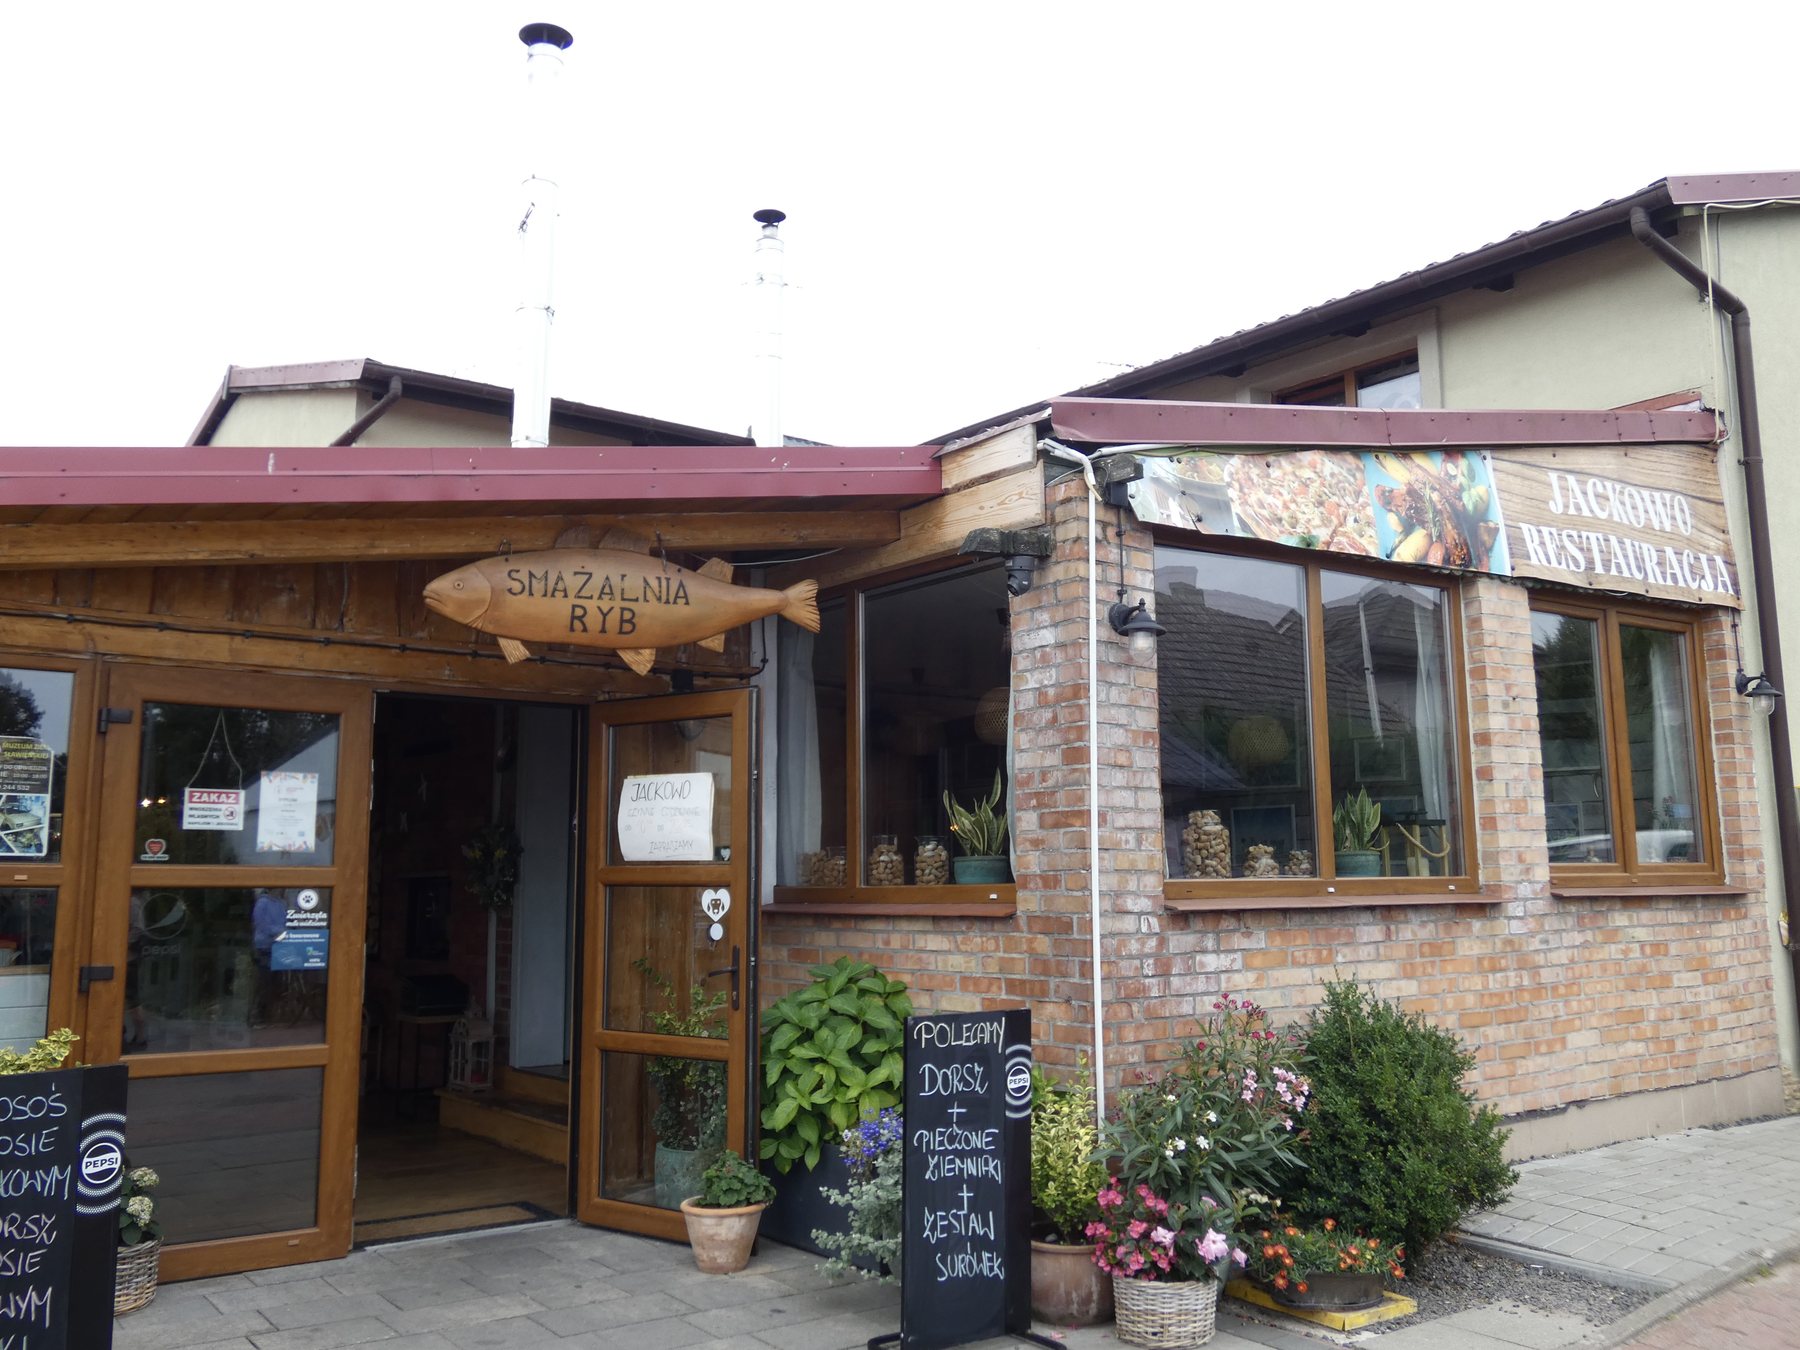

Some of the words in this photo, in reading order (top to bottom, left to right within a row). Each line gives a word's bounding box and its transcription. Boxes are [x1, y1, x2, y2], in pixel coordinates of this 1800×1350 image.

[1548, 471, 1692, 536] JACKOWO
[1519, 522, 1734, 595] RESTAURACJA
[506, 565, 690, 606] SMAŻALNIA
[568, 604, 637, 635] RYB
[191, 792, 237, 803] ZAKAZ
[630, 780, 691, 802] JACKOWO
[913, 1016, 1005, 1054] POLECAMY
[919, 1062, 989, 1096] DORSZ
[913, 1123, 999, 1153] PIECZONE
[85, 1157, 119, 1170] PEPSI
[925, 1154, 1002, 1184] ZIEMNIAKI
[0, 1212, 57, 1245] RSZ
[922, 1206, 995, 1244] ZESTAW
[0, 1248, 48, 1276] SIE
[935, 1241, 1005, 1281] SURÓWEK
